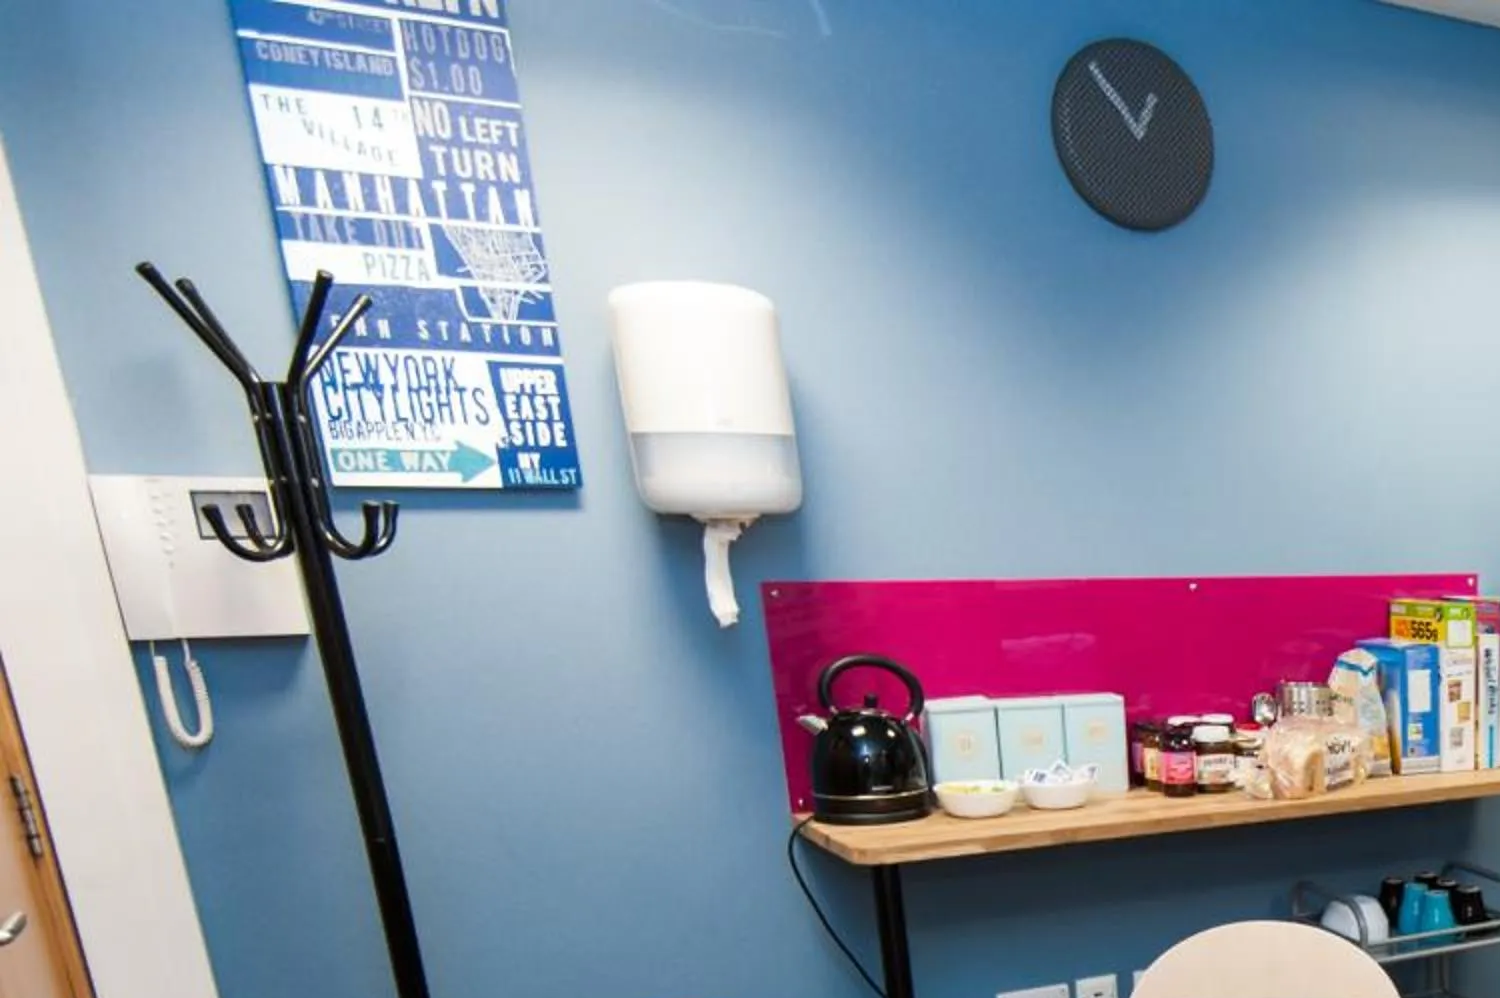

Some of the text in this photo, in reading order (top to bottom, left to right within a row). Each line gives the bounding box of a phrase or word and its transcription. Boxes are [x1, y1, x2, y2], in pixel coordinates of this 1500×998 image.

[409, 56, 482, 96] $1.00
[259, 93, 307, 115] THE
[411, 97, 518, 147] NO LEFT
[429, 145, 521, 184] TURN
[274, 165, 535, 229] MANHATTAN
[289, 213, 425, 250] TAKE OUT
[362, 252, 432, 281] PIZZA
[416, 318, 554, 347] STATION
[499, 367, 559, 394] UPPER
[504, 394, 560, 420] EAST
[509, 420, 567, 447] SIDE
[338, 449, 450, 472] ONE WAY
[1411, 620, 1438, 642] 565g
